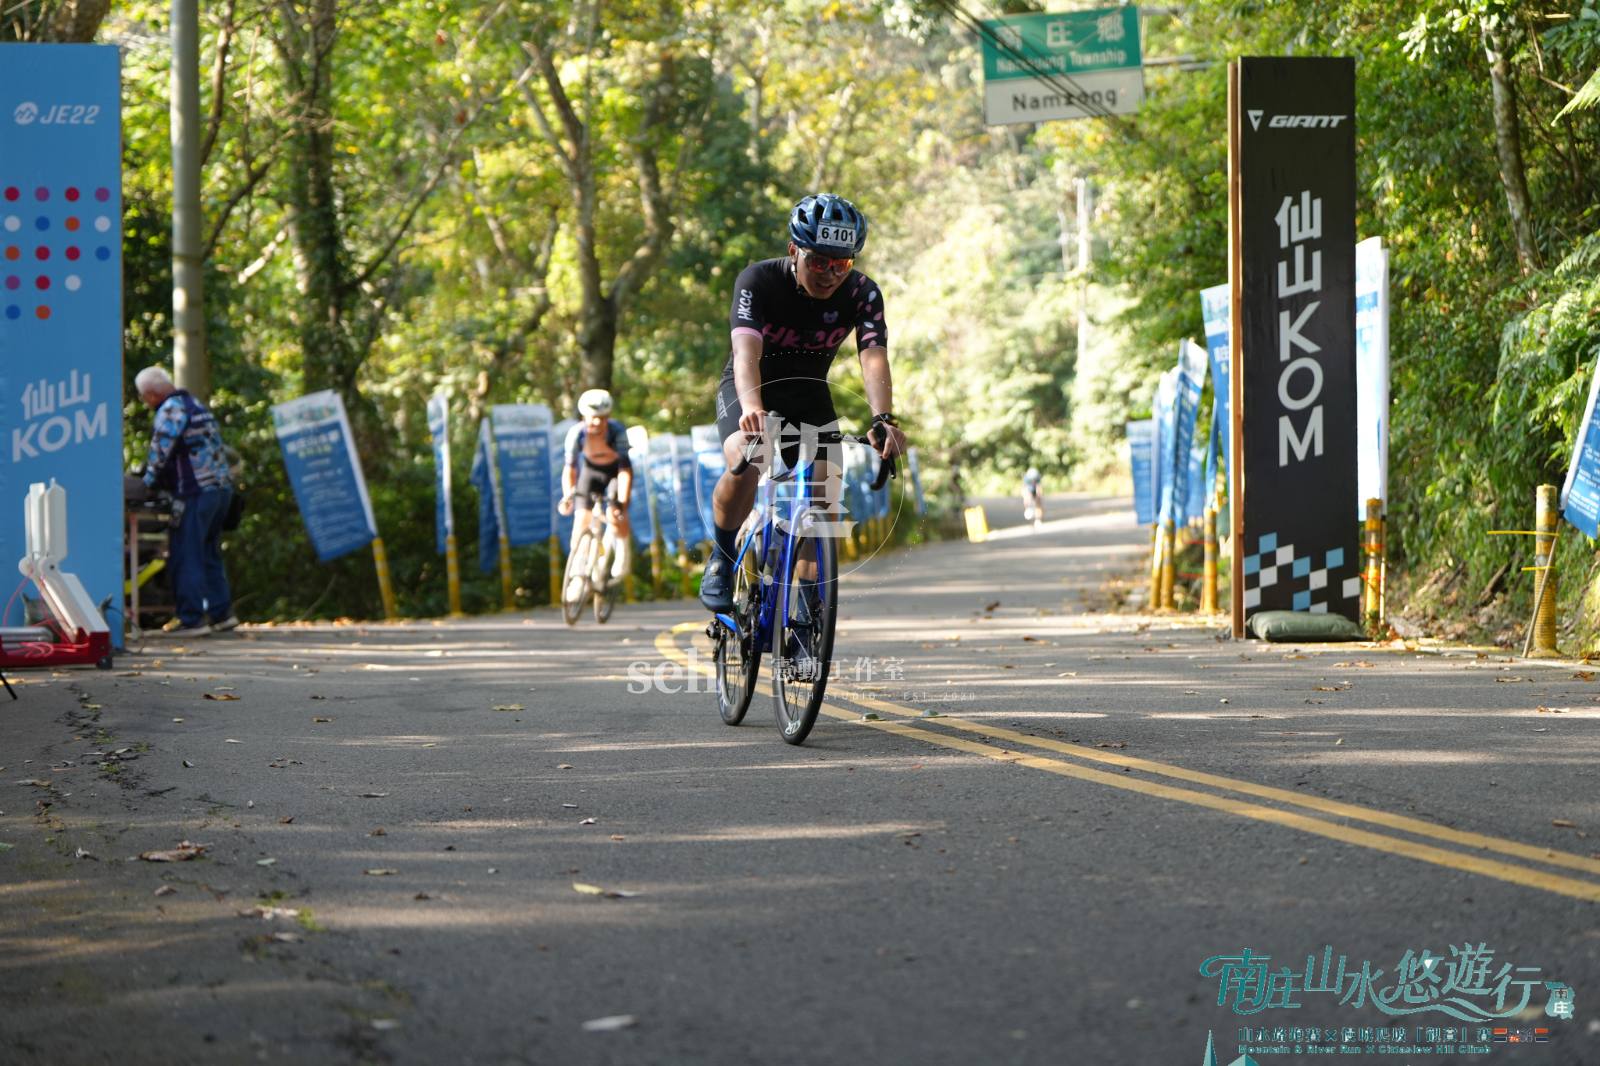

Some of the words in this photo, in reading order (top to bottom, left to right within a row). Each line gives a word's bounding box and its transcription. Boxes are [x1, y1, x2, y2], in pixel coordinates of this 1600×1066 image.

[40, 104, 101, 124] JE22
[1268, 115, 1348, 128] GIANT
[1274, 189, 1322, 299] 仙山
[738, 288, 753, 321] HKCC
[20, 368, 92, 421] 仙山
[1277, 300, 1324, 467] KOM
[12, 401, 108, 464] KOM
